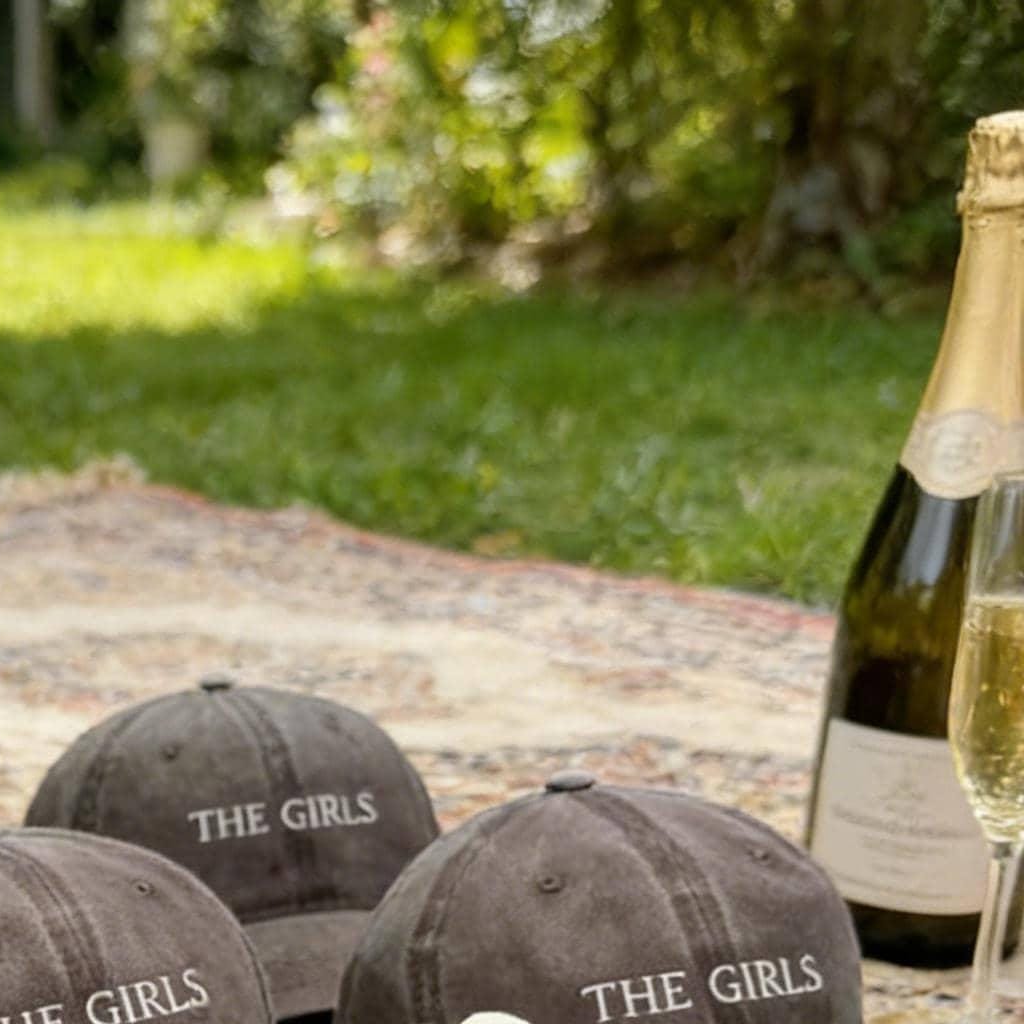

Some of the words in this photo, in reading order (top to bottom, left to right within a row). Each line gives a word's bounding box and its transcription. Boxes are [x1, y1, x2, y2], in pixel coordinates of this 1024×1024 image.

[187, 802, 270, 843] THE
[280, 791, 378, 831] GIRLS
[580, 971, 693, 1023] THE
[708, 954, 823, 1003] GIRLS
